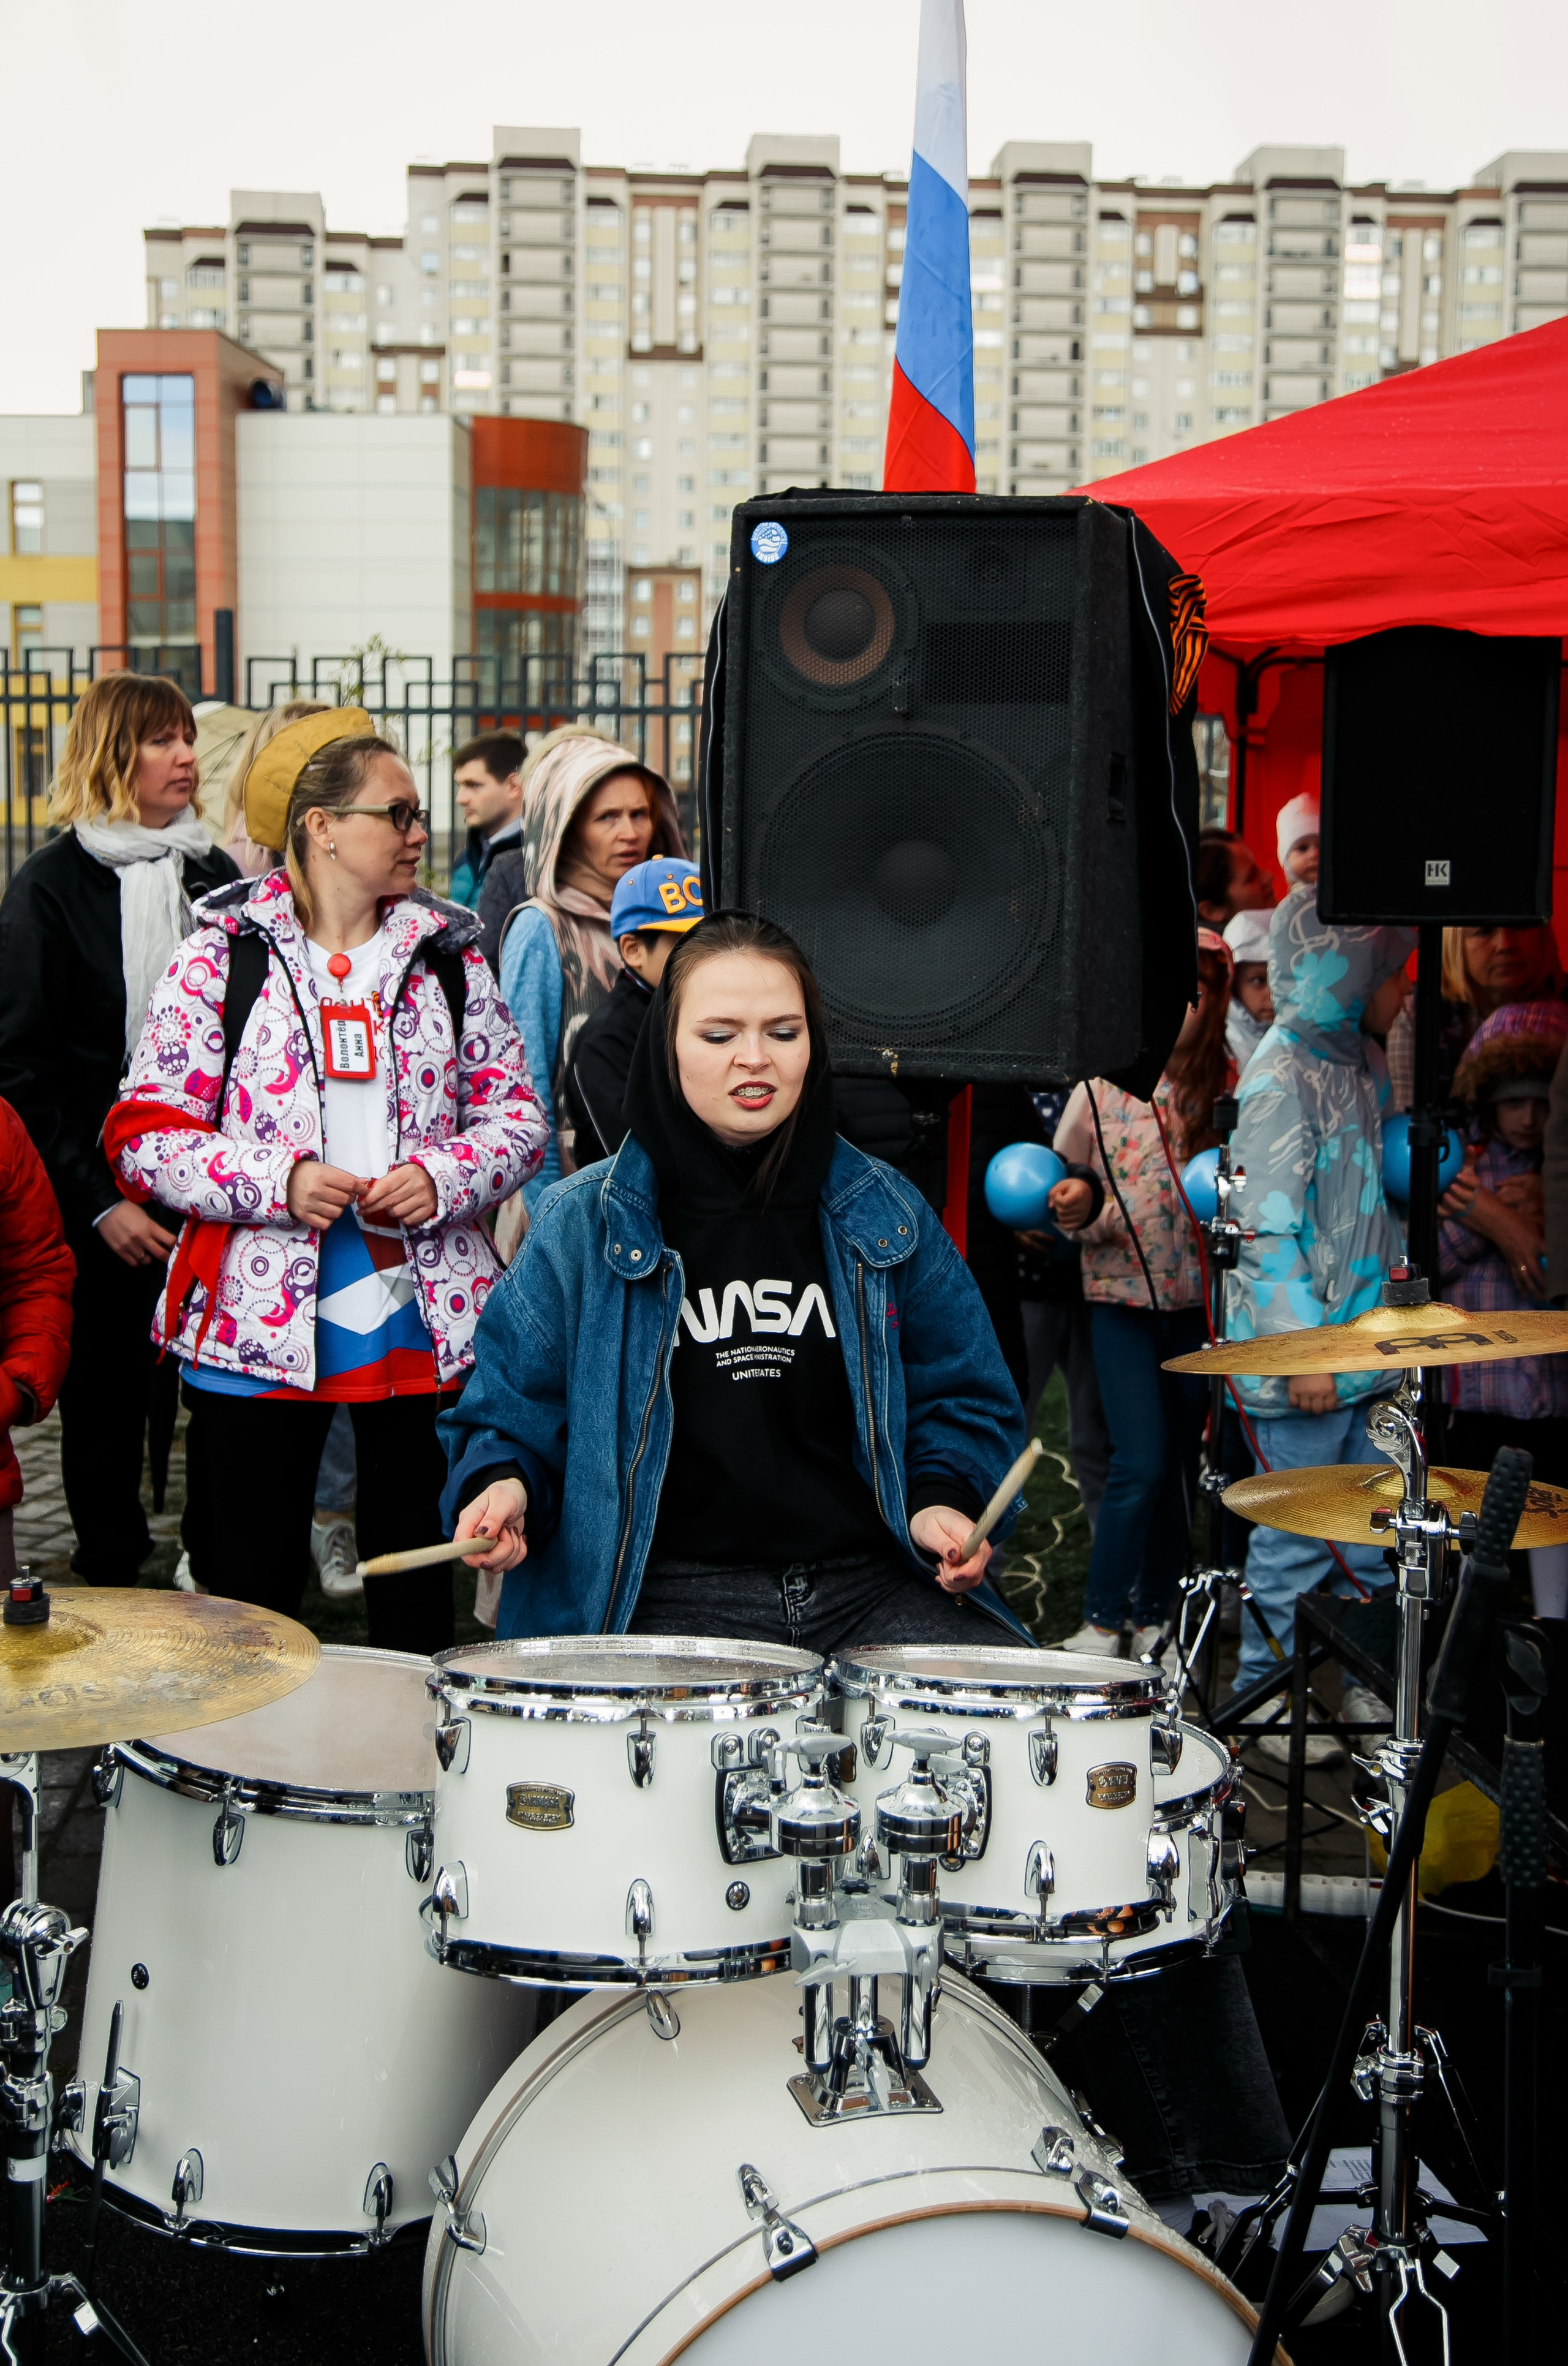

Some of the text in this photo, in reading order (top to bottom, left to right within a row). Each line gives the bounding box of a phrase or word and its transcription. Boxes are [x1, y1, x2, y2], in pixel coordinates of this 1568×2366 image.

[1427, 863, 1448, 877] HK
[354, 1034, 364, 1057] Анна
[673, 1279, 836, 1347] NASA
[715, 1351, 729, 1359] THE
[716, 1358, 732, 1367] AND
[733, 1353, 754, 1363] SPACE
